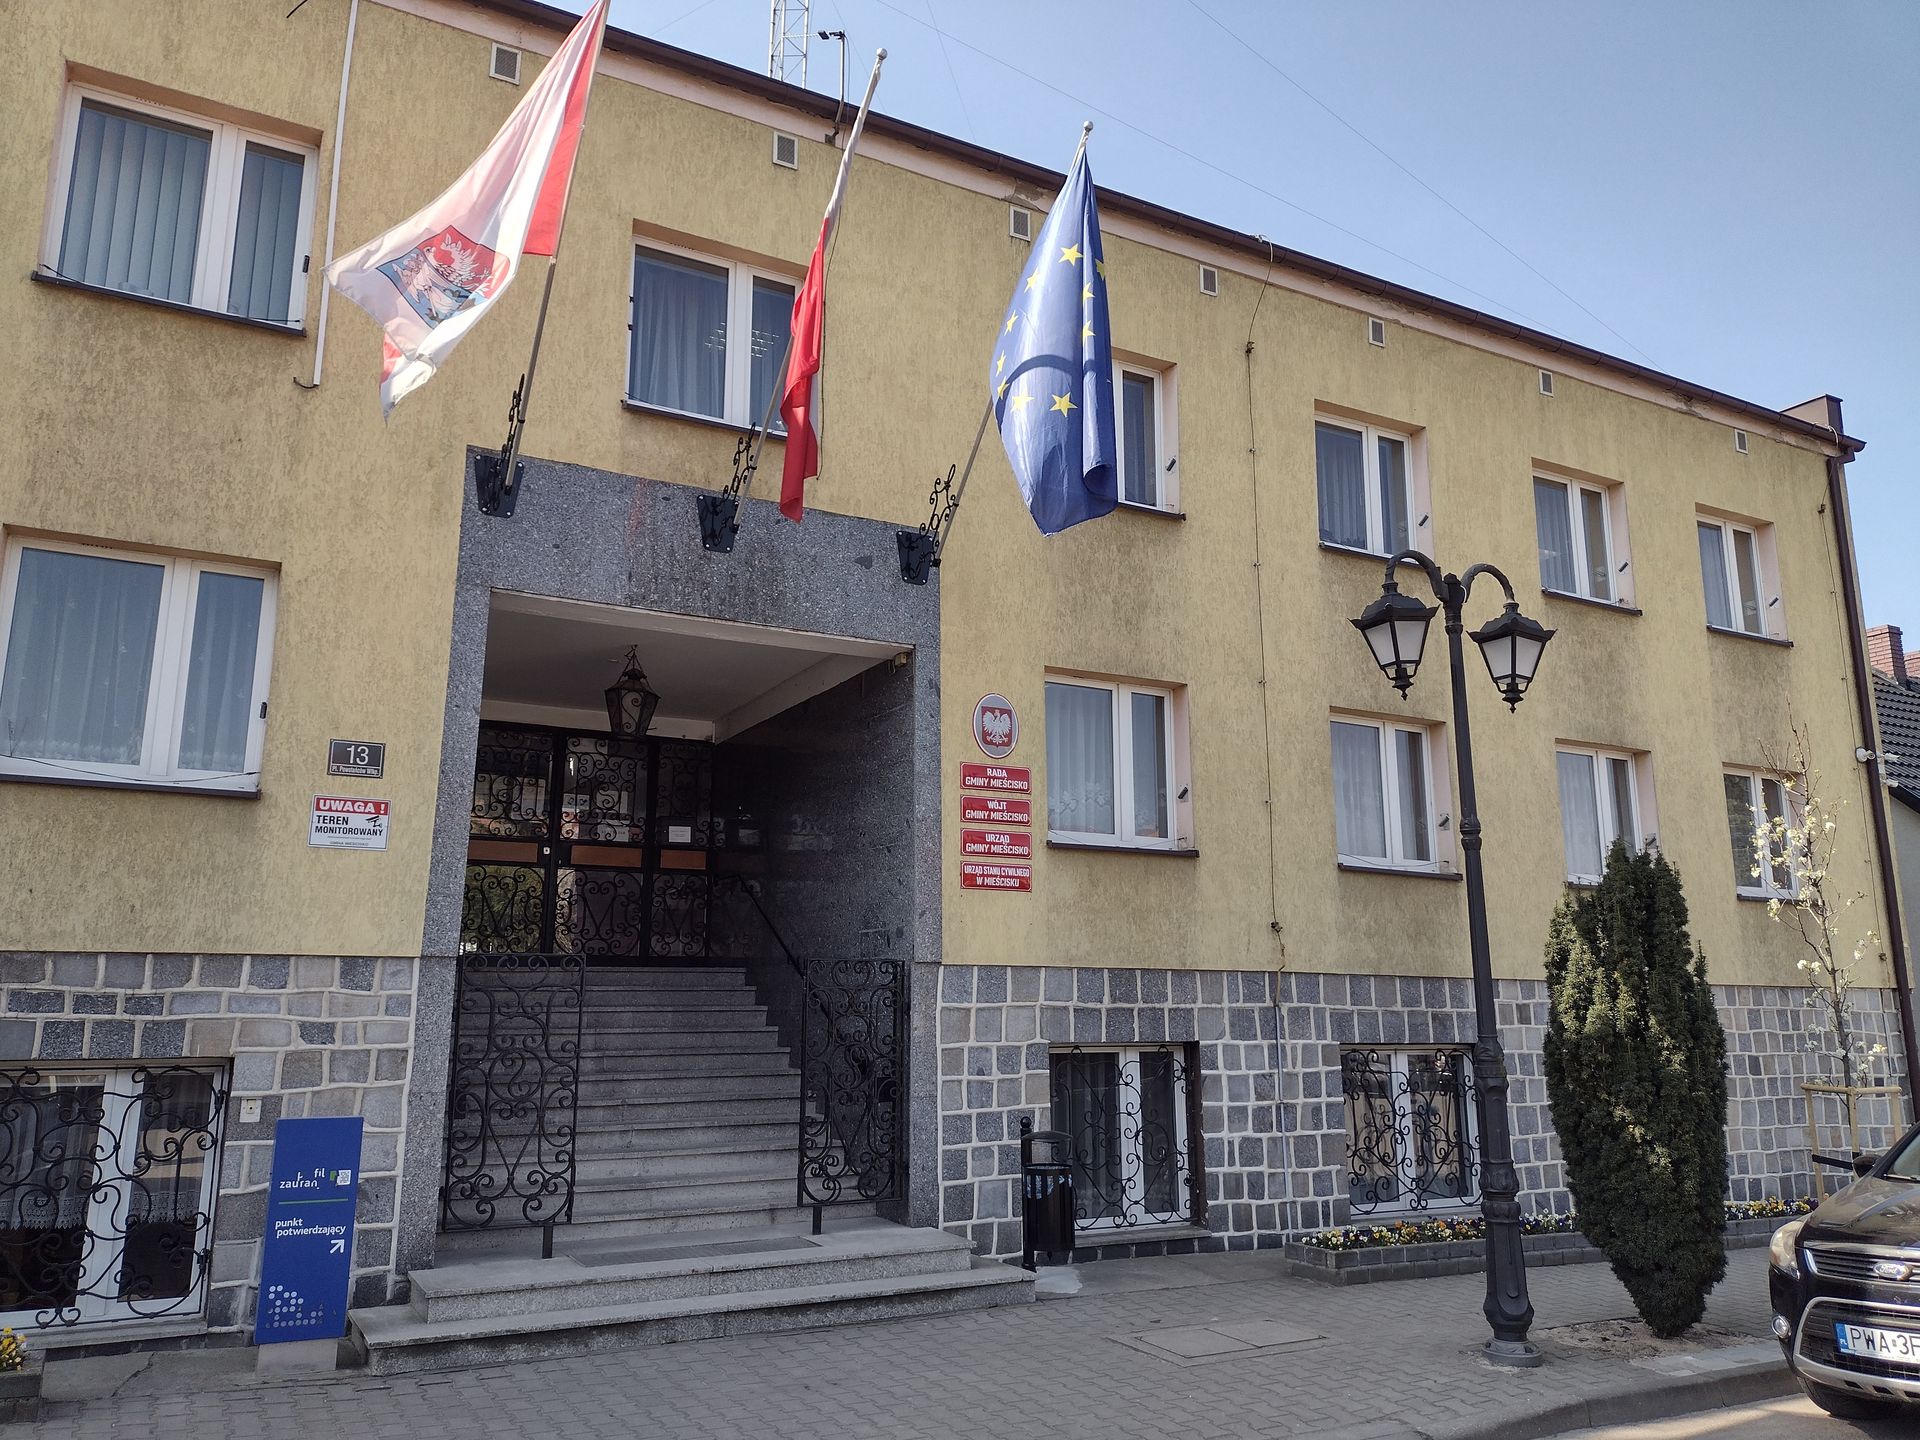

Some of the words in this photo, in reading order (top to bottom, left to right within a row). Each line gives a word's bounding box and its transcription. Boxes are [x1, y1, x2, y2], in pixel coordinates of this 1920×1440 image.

[346, 745, 369, 765] 13
[986, 768, 1008, 778] RADA
[965, 776, 989, 787] GMINY
[990, 777, 1028, 790] MIEŚCISKO
[319, 799, 376, 813] UWAGA
[987, 799, 1007, 810] WÓJT
[316, 814, 349, 826] TEREN
[965, 809, 989, 820] GMINY
[990, 810, 1028, 822] MIEŚCISKO
[315, 825, 384, 836] MONITOROWANY
[985, 833, 1010, 845] URZĄD
[965, 842, 989, 853] GMINY
[990, 843, 1029, 855] MIEŚCISKO
[964, 865, 983, 876] URZĄD
[983, 866, 1001, 875] STANU
[1001, 867, 1030, 878] CYWILNEGO
[976, 876, 983, 886] W
[984, 876, 1020, 887] MIEŚCISKU
[275, 1217, 303, 1230] punkt
[276, 1225, 346, 1239] potwierdzający
[1850, 1327, 1891, 1353] PWA
[1896, 1334, 1920, 1357] 3F
